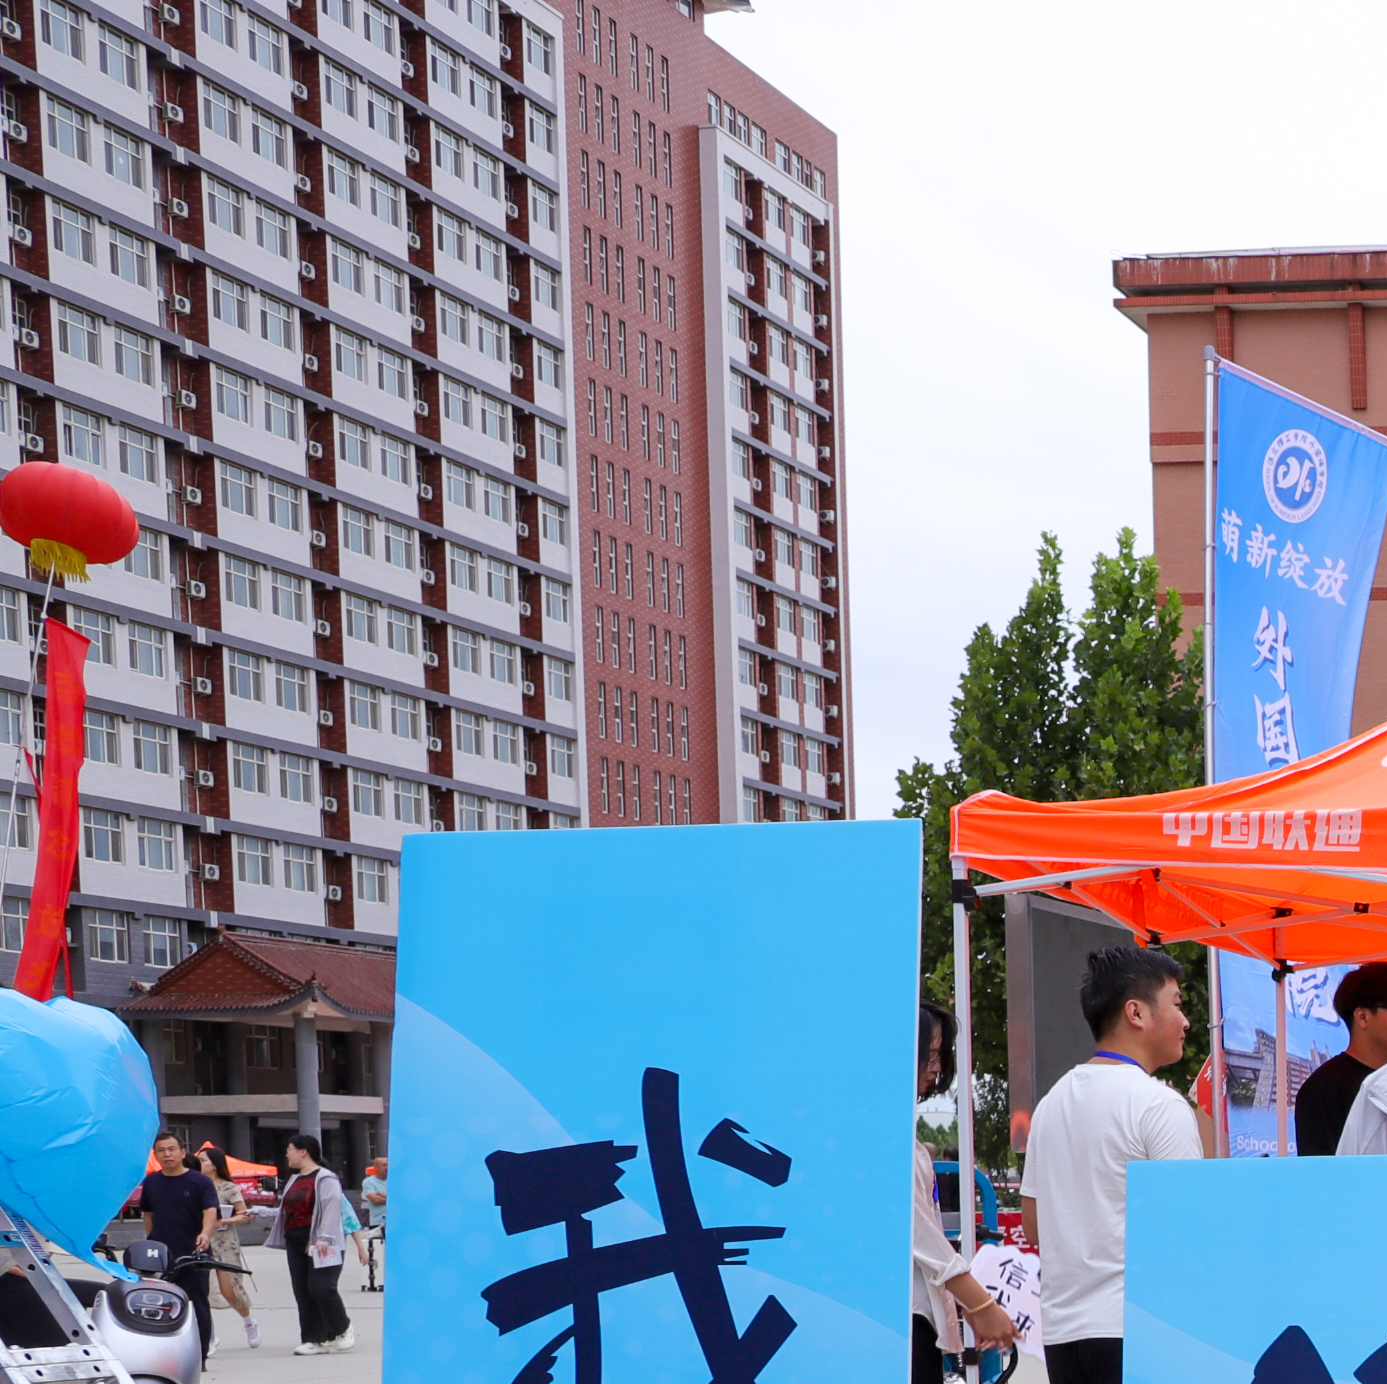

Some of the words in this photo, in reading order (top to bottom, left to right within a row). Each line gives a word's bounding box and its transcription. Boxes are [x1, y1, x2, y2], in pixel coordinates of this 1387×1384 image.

[1221, 507, 1349, 606] 萌新绽放
[1251, 605, 1300, 768] 外国
[1162, 809, 1363, 852] 中国联通
[1237, 1135, 1278, 1152] Schoo
